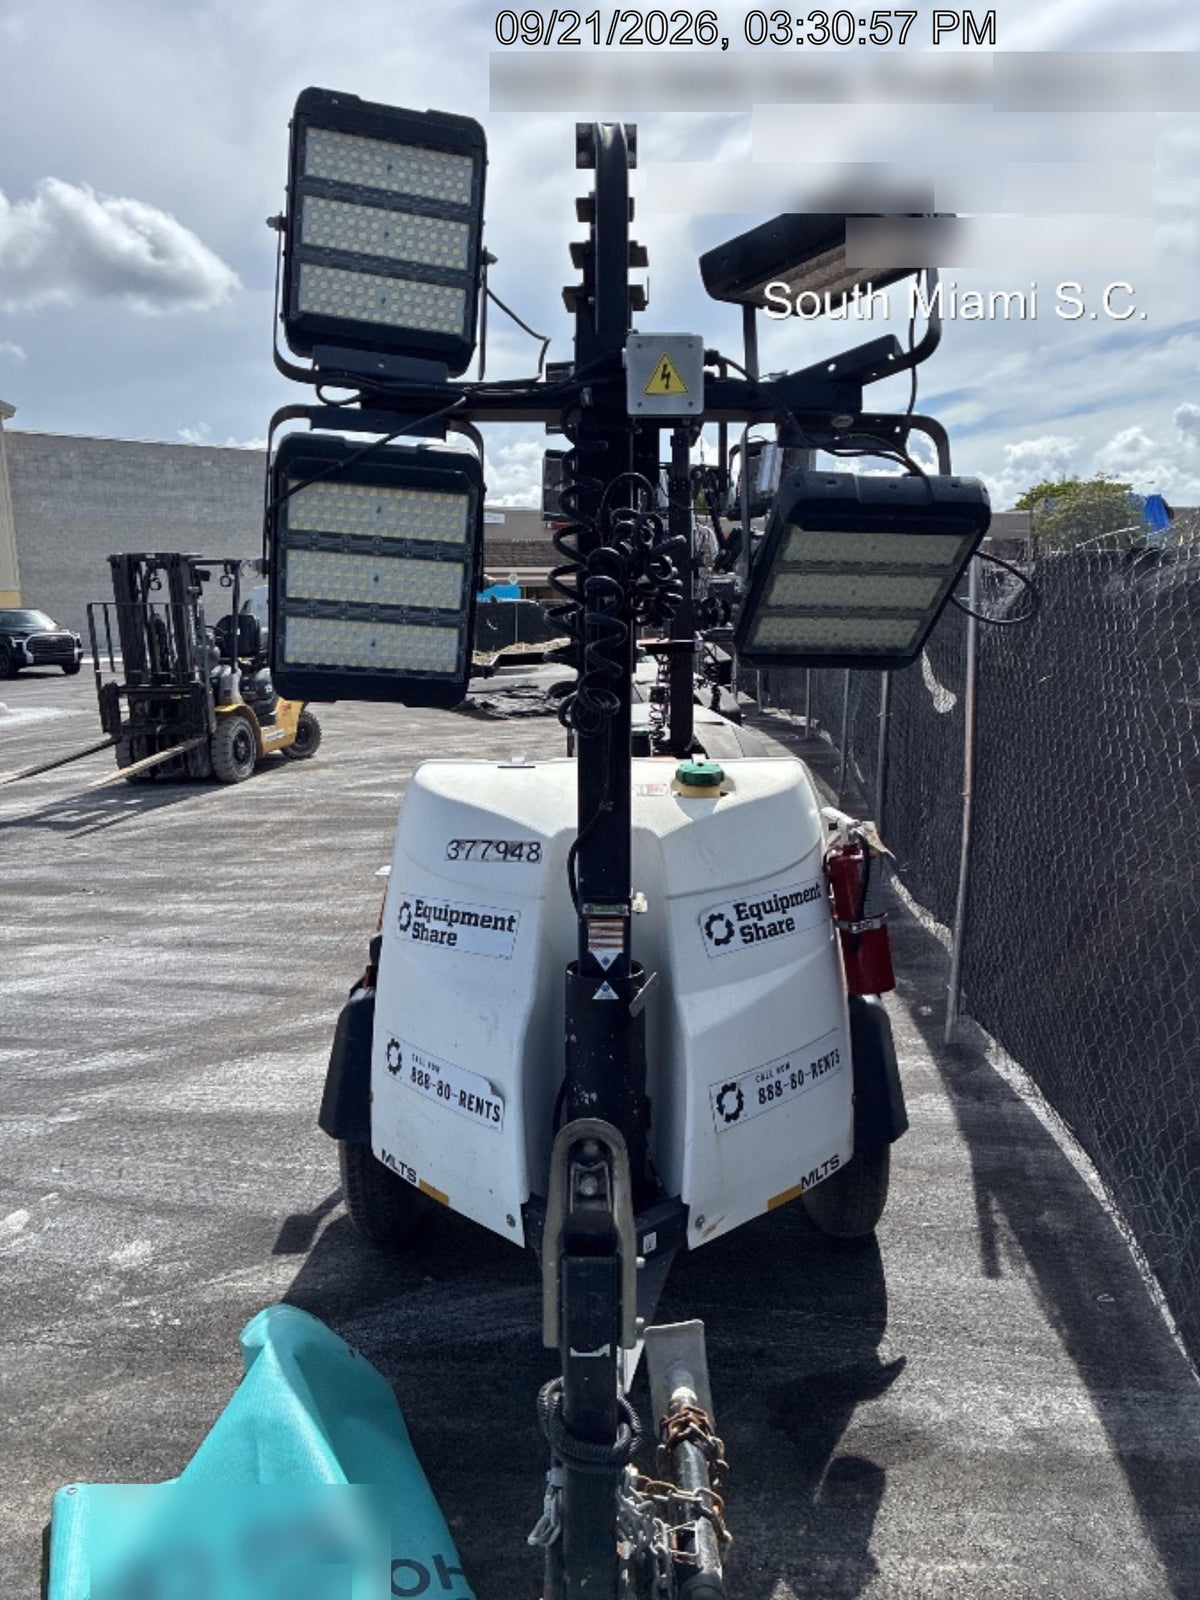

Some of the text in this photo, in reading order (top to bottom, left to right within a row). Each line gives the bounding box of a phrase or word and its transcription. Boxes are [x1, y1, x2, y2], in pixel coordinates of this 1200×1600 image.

[446, 839, 541, 863] 377948
[414, 899, 516, 933] Equipment
[734, 882, 822, 921] Equipment
[411, 921, 458, 946] Share
[740, 917, 795, 944] Share
[411, 1066, 501, 1122] 888-80-RENTS
[381, 1148, 417, 1184] MLTS
[801, 1155, 840, 1190] MLTS
